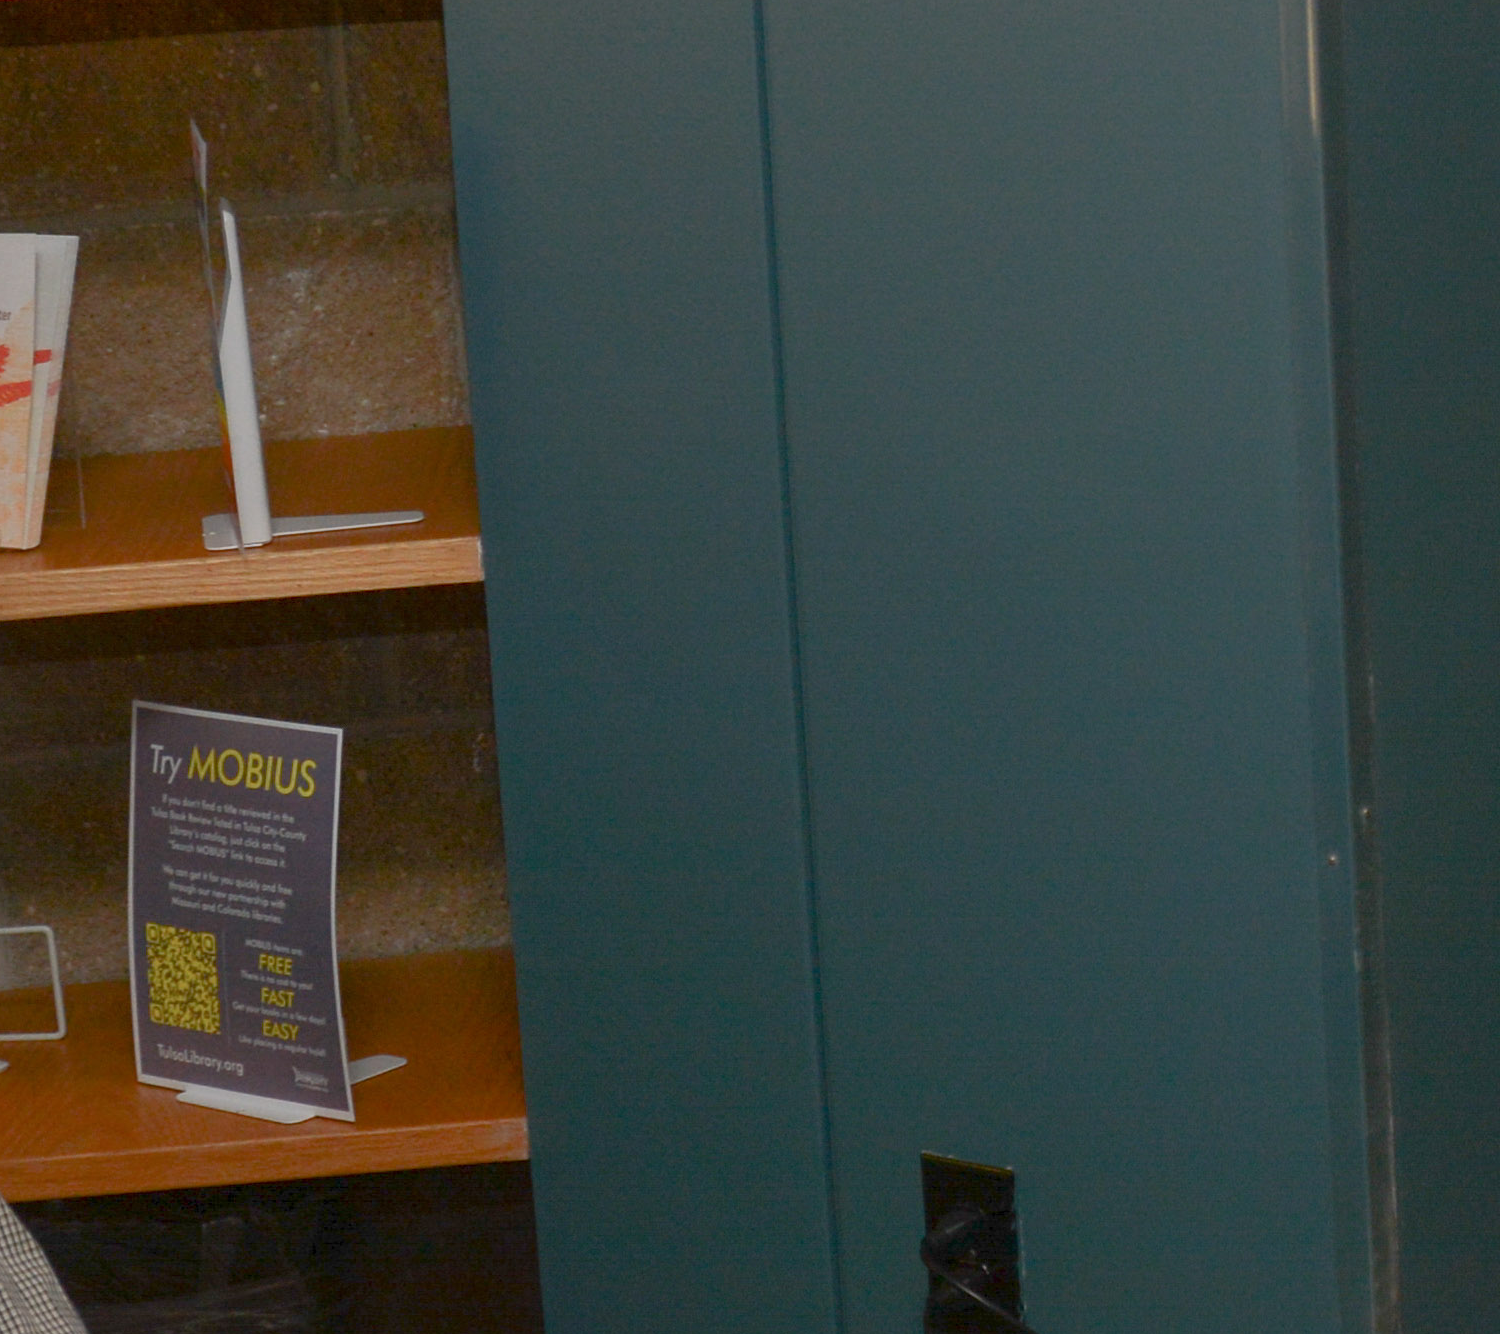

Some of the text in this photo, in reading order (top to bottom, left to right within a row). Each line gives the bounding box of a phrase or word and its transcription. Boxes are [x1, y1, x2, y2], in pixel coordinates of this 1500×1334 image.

[150, 744, 317, 798] Try MOBIUS
[182, 796, 200, 808] don't
[201, 799, 216, 811] find
[223, 803, 237, 815] title
[239, 808, 271, 820] reviewed
[282, 813, 295, 824] the
[151, 806, 169, 818] Tulsa
[170, 810, 186, 821] Book
[188, 813, 212, 825] Review
[213, 816, 233, 829] listed
[243, 821, 261, 834] Tulsa
[262, 825, 307, 843] City-County
[169, 825, 199, 840] Library's
[244, 837, 260, 849] click
[273, 842, 286, 854] the
[230, 849, 244, 861] link
[255, 856, 278, 868] access
[168, 880, 196, 895] through
[228, 892, 269, 908] partnership
[270, 898, 286, 910] with
[236, 878, 260, 893] quickly
[261, 882, 277, 893] and
[278, 883, 293, 896] free
[171, 897, 200, 909] Missouri
[201, 901, 216, 913] and
[217, 903, 251, 919] Colorado
[244, 939, 272, 951] MOBIUS
[241, 969, 259, 981] There
[258, 953, 293, 977] FREE
[232, 1000, 245, 1010] Get
[261, 1007, 280, 1017] books
[261, 986, 295, 1009] FAST
[263, 1018, 299, 1043] EASY
[253, 1037, 277, 1051] placing
[284, 1043, 307, 1055] regular
[157, 1043, 245, 1078] TulsaLibrary.org
